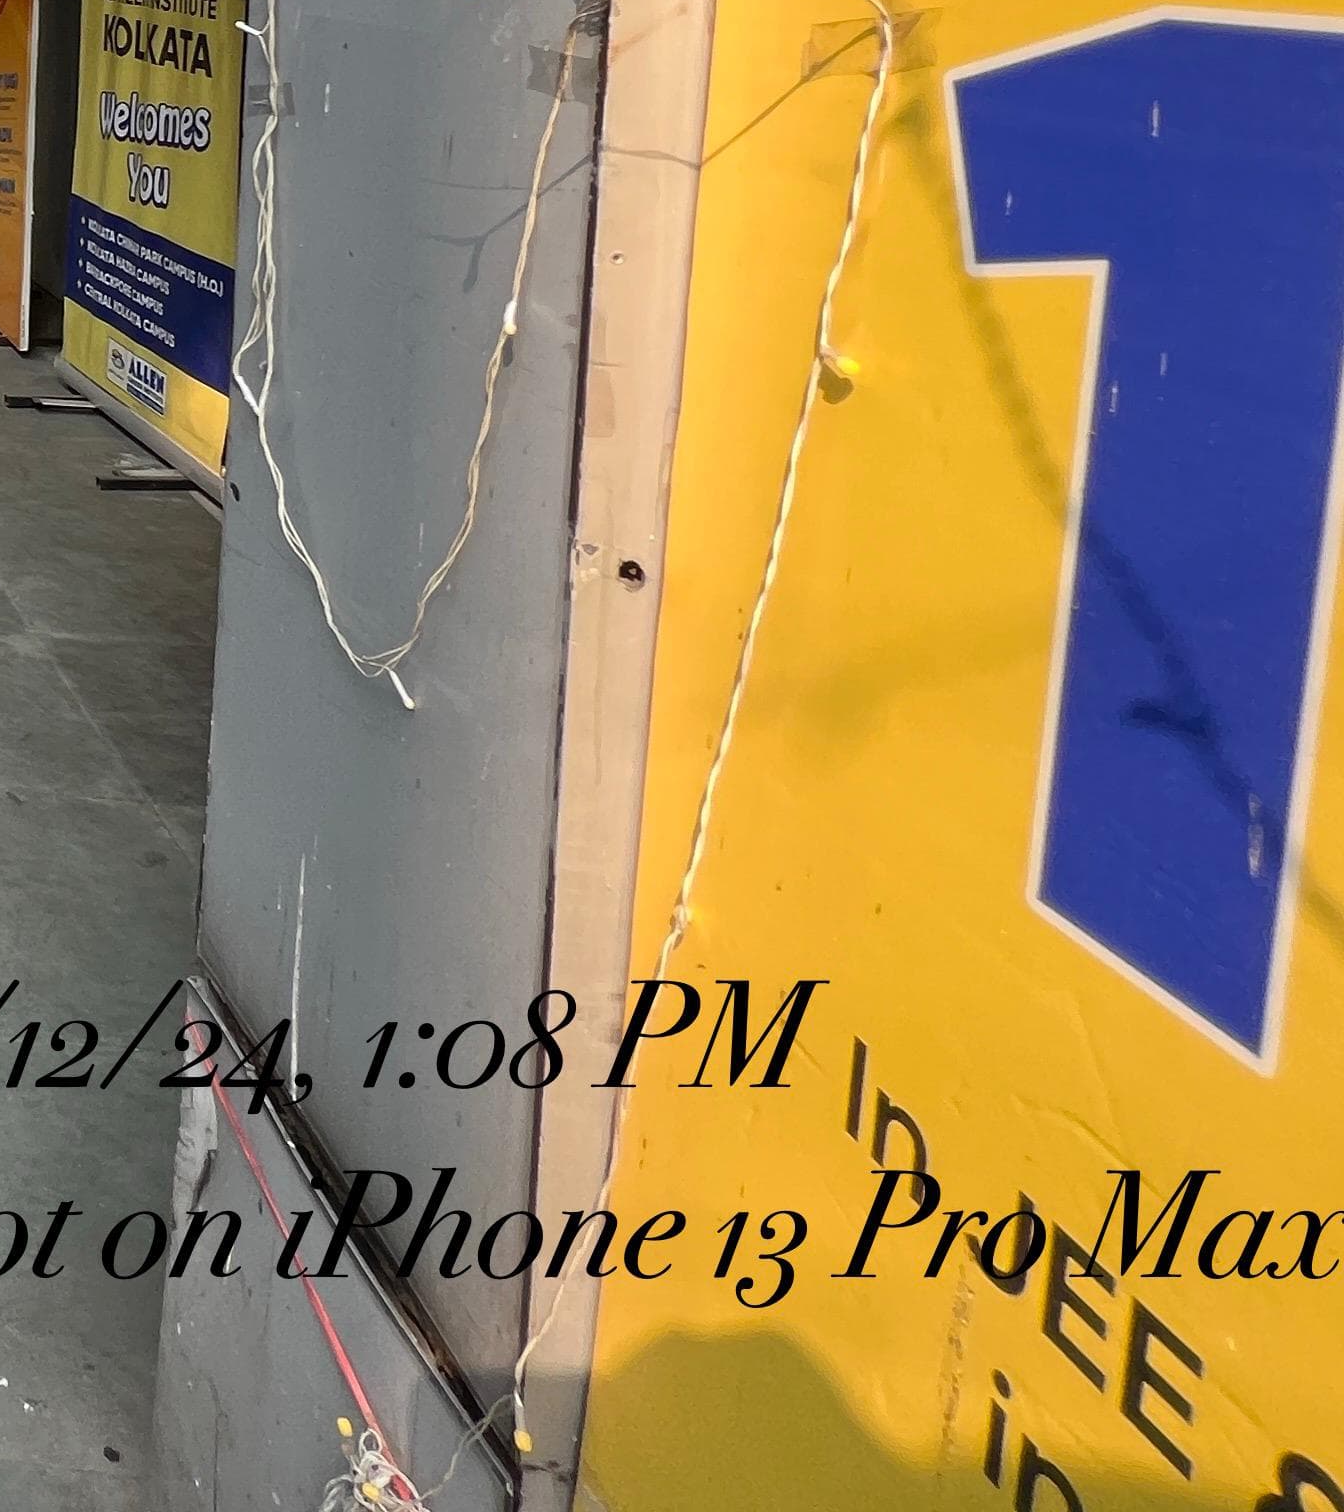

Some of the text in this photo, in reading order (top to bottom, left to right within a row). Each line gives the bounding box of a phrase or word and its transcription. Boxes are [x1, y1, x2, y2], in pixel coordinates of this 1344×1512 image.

[104, 13, 212, 78] KOLKATA
[100, 91, 211, 152] Welcomes
[127, 152, 170, 209] You
[163, 257, 197, 285] CAMPUS
[844, 1035, 928, 1207] In
[964, 1190, 1206, 1482] JEE
